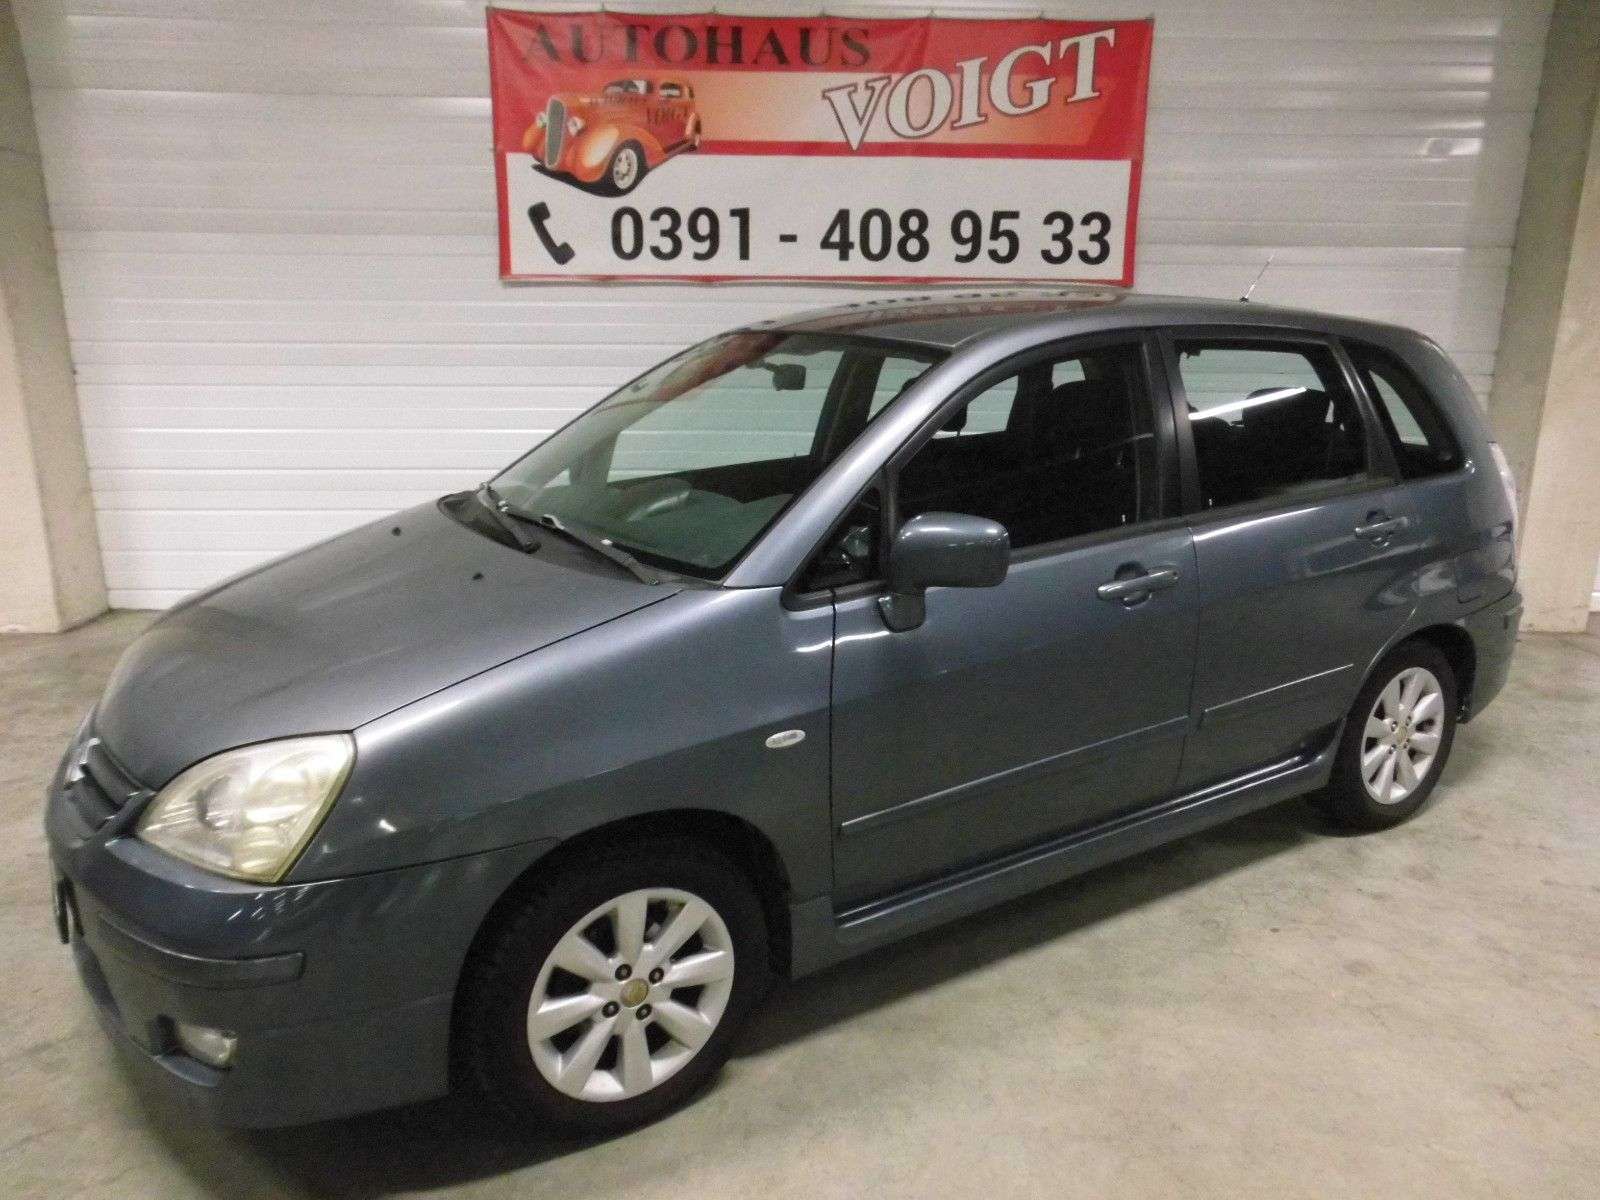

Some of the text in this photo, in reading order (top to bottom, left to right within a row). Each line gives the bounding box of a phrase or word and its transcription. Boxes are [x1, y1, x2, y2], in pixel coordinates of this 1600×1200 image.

[523, 24, 871, 67] AUTOHAUS
[823, 28, 1115, 151] VOIGT
[612, 207, 749, 261] 0391
[820, 208, 930, 262] 408
[951, 209, 1020, 264] 95
[1040, 211, 1111, 265] 33
